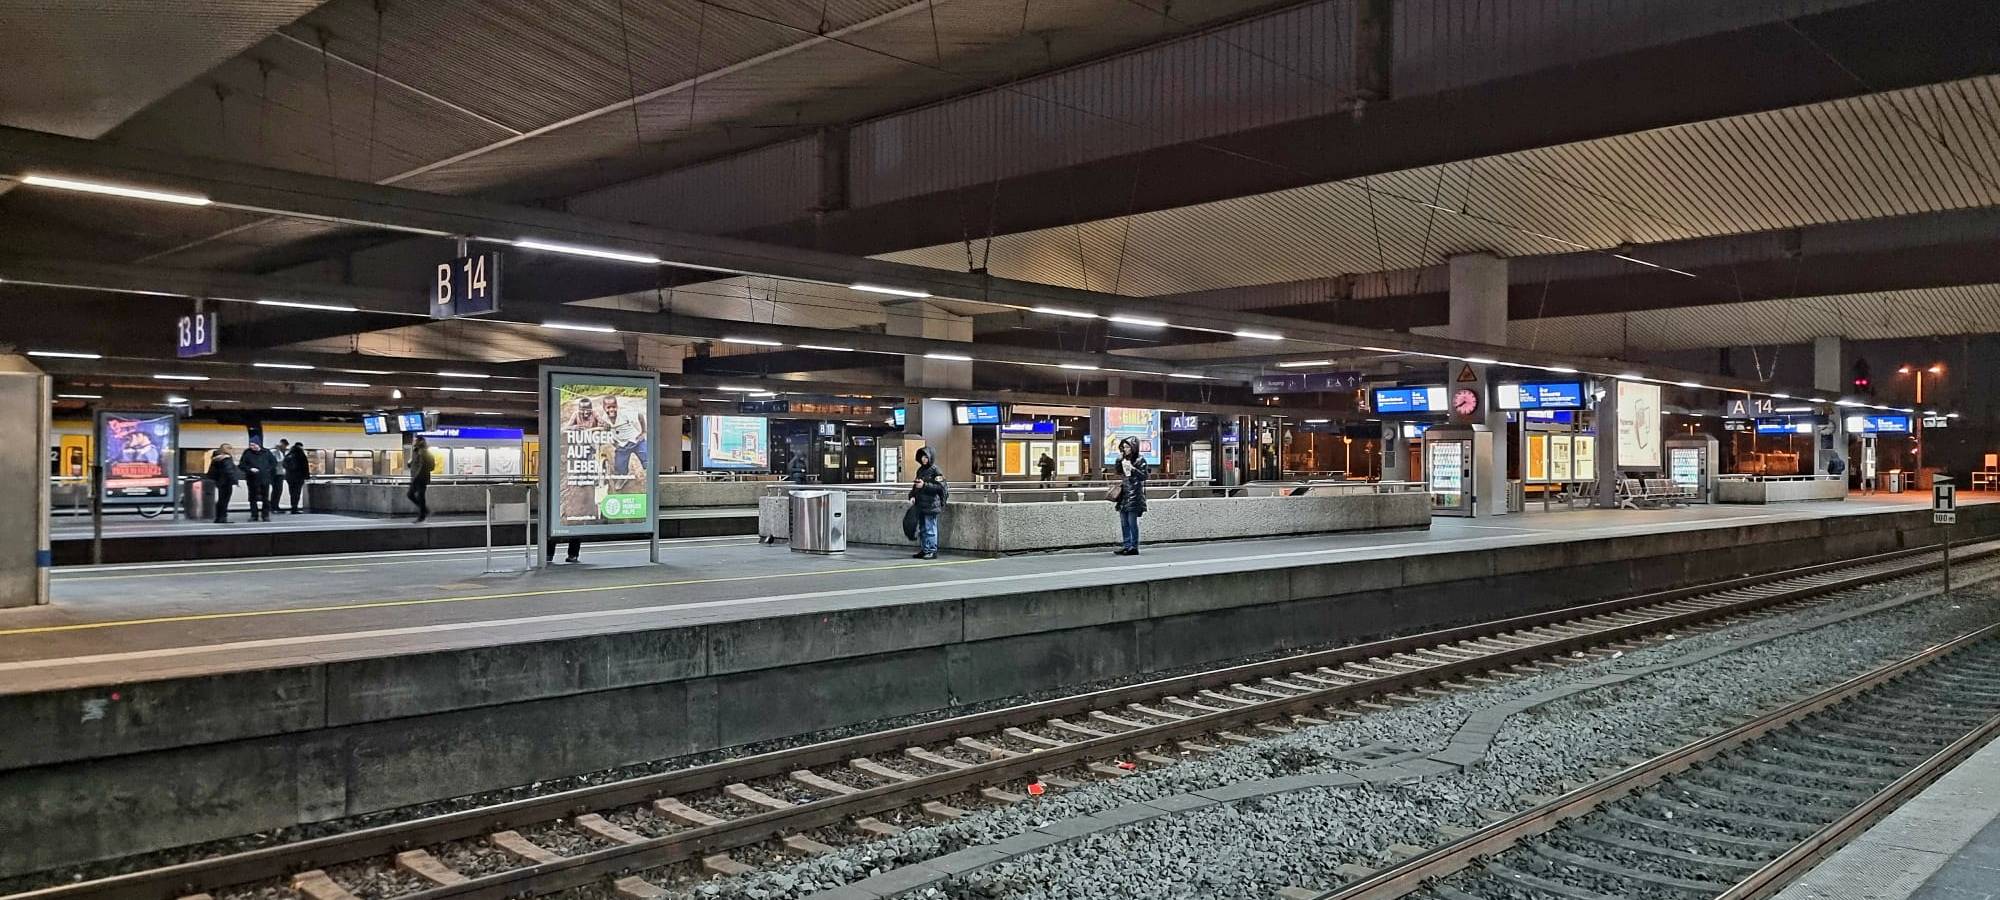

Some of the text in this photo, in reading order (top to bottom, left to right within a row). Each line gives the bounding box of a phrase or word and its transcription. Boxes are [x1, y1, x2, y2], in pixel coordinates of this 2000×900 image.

[438, 255, 487, 305] B 14
[179, 314, 205, 347] 13 B
[1733, 399, 1773, 414] A 14
[1174, 416, 1196, 428] A 12
[567, 430, 615, 444] HUNGER
[567, 446, 591, 459] AUF
[567, 460, 606, 473] LEBEN.
[1936, 486, 1953, 509] H
[1935, 513, 1948, 522] 100
